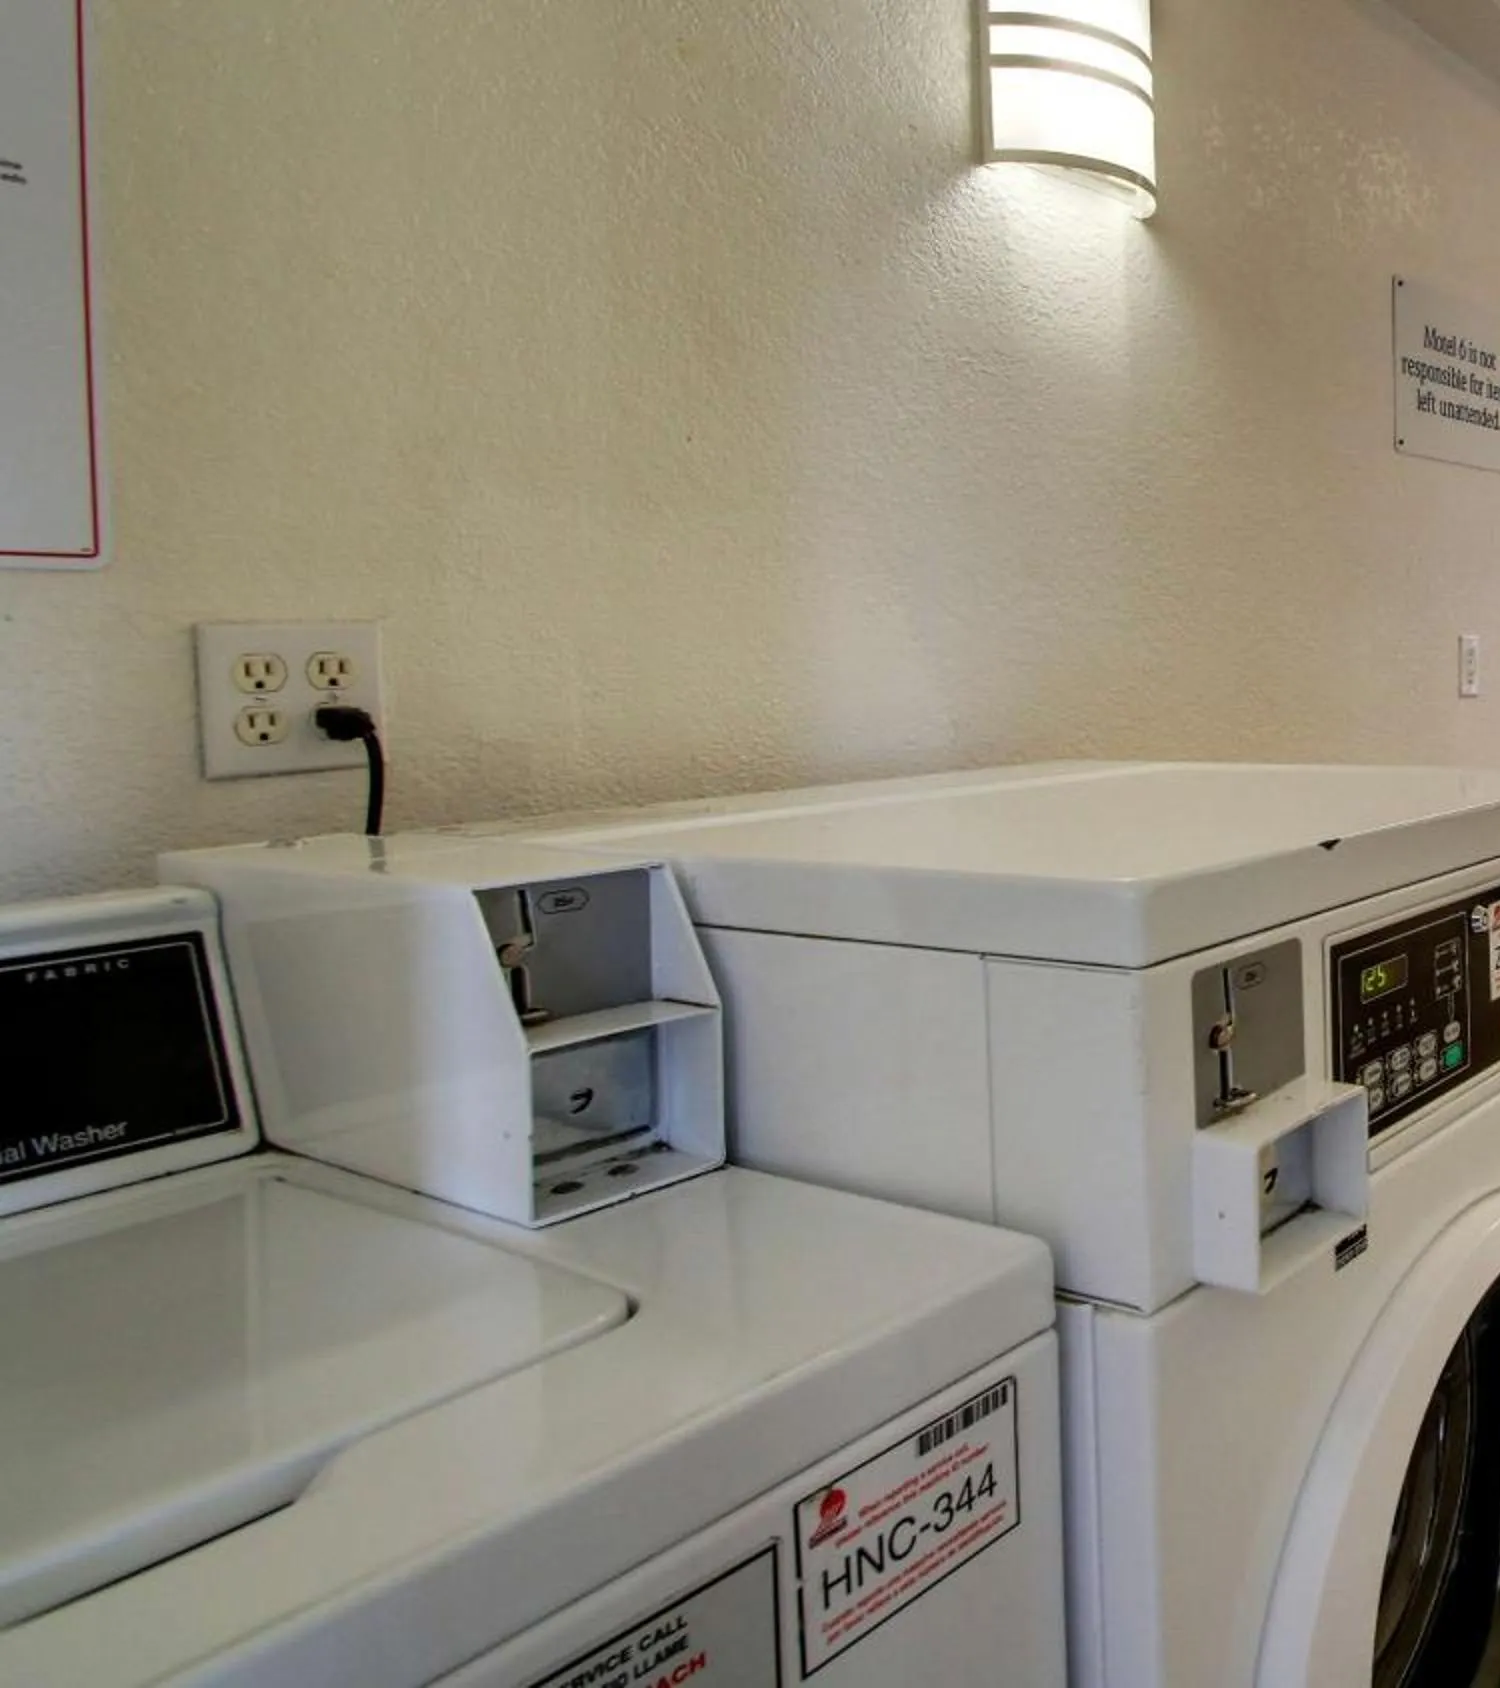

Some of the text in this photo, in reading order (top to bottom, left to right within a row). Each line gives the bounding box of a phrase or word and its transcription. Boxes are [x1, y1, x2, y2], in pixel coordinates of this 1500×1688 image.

[1423, 325, 1497, 370] Motel 6 is not
[1401, 356, 1467, 392] responsible
[1469, 372, 1485, 396] for
[1416, 388, 1437, 414] left
[25, 959, 129, 984] FABRIC
[30, 1121, 128, 1156] Washer
[822, 1462, 998, 1610] HNC-344
[638, 1615, 688, 1652] CALL
[633, 1635, 689, 1679] LLAME
